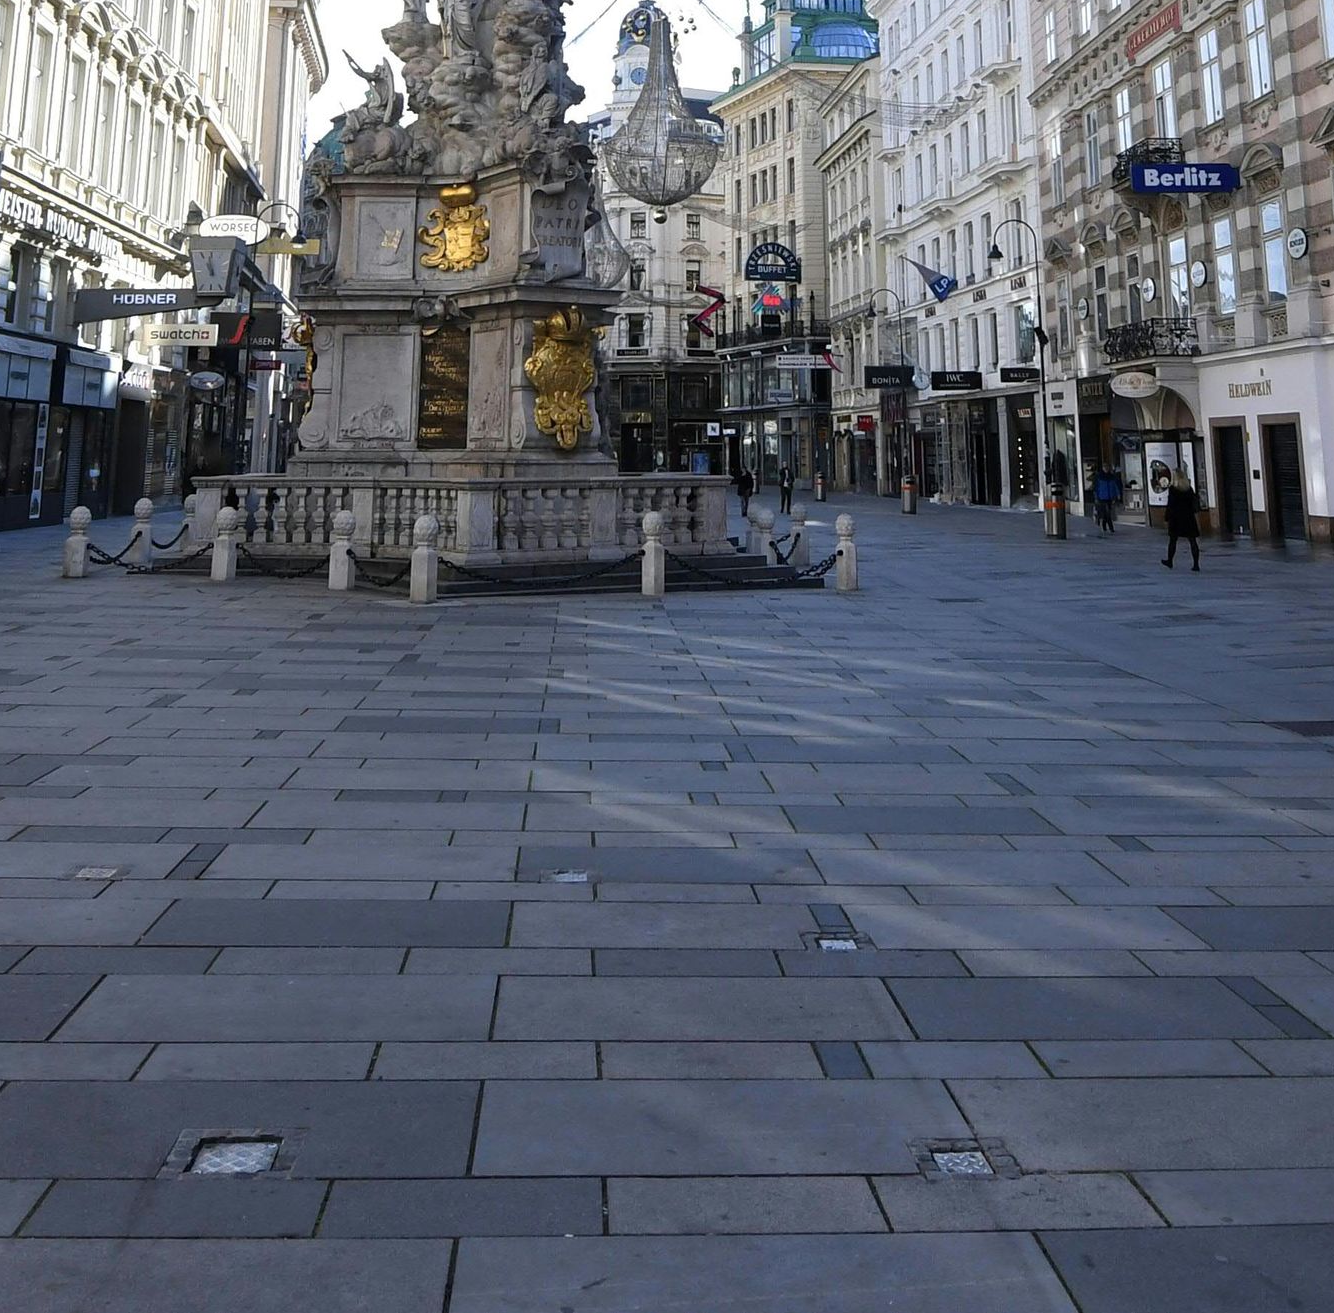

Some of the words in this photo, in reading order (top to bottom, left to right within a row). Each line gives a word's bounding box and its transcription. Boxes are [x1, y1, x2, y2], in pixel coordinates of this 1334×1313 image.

[1143, 167, 1222, 187] Berlitz
[757, 265, 786, 274] BUFFET
[113, 293, 177, 305] HÜBNER
[150, 329, 201, 340] swatch
[945, 374, 965, 383] IWC
[1228, 379, 1272, 398] HELDWEIN
